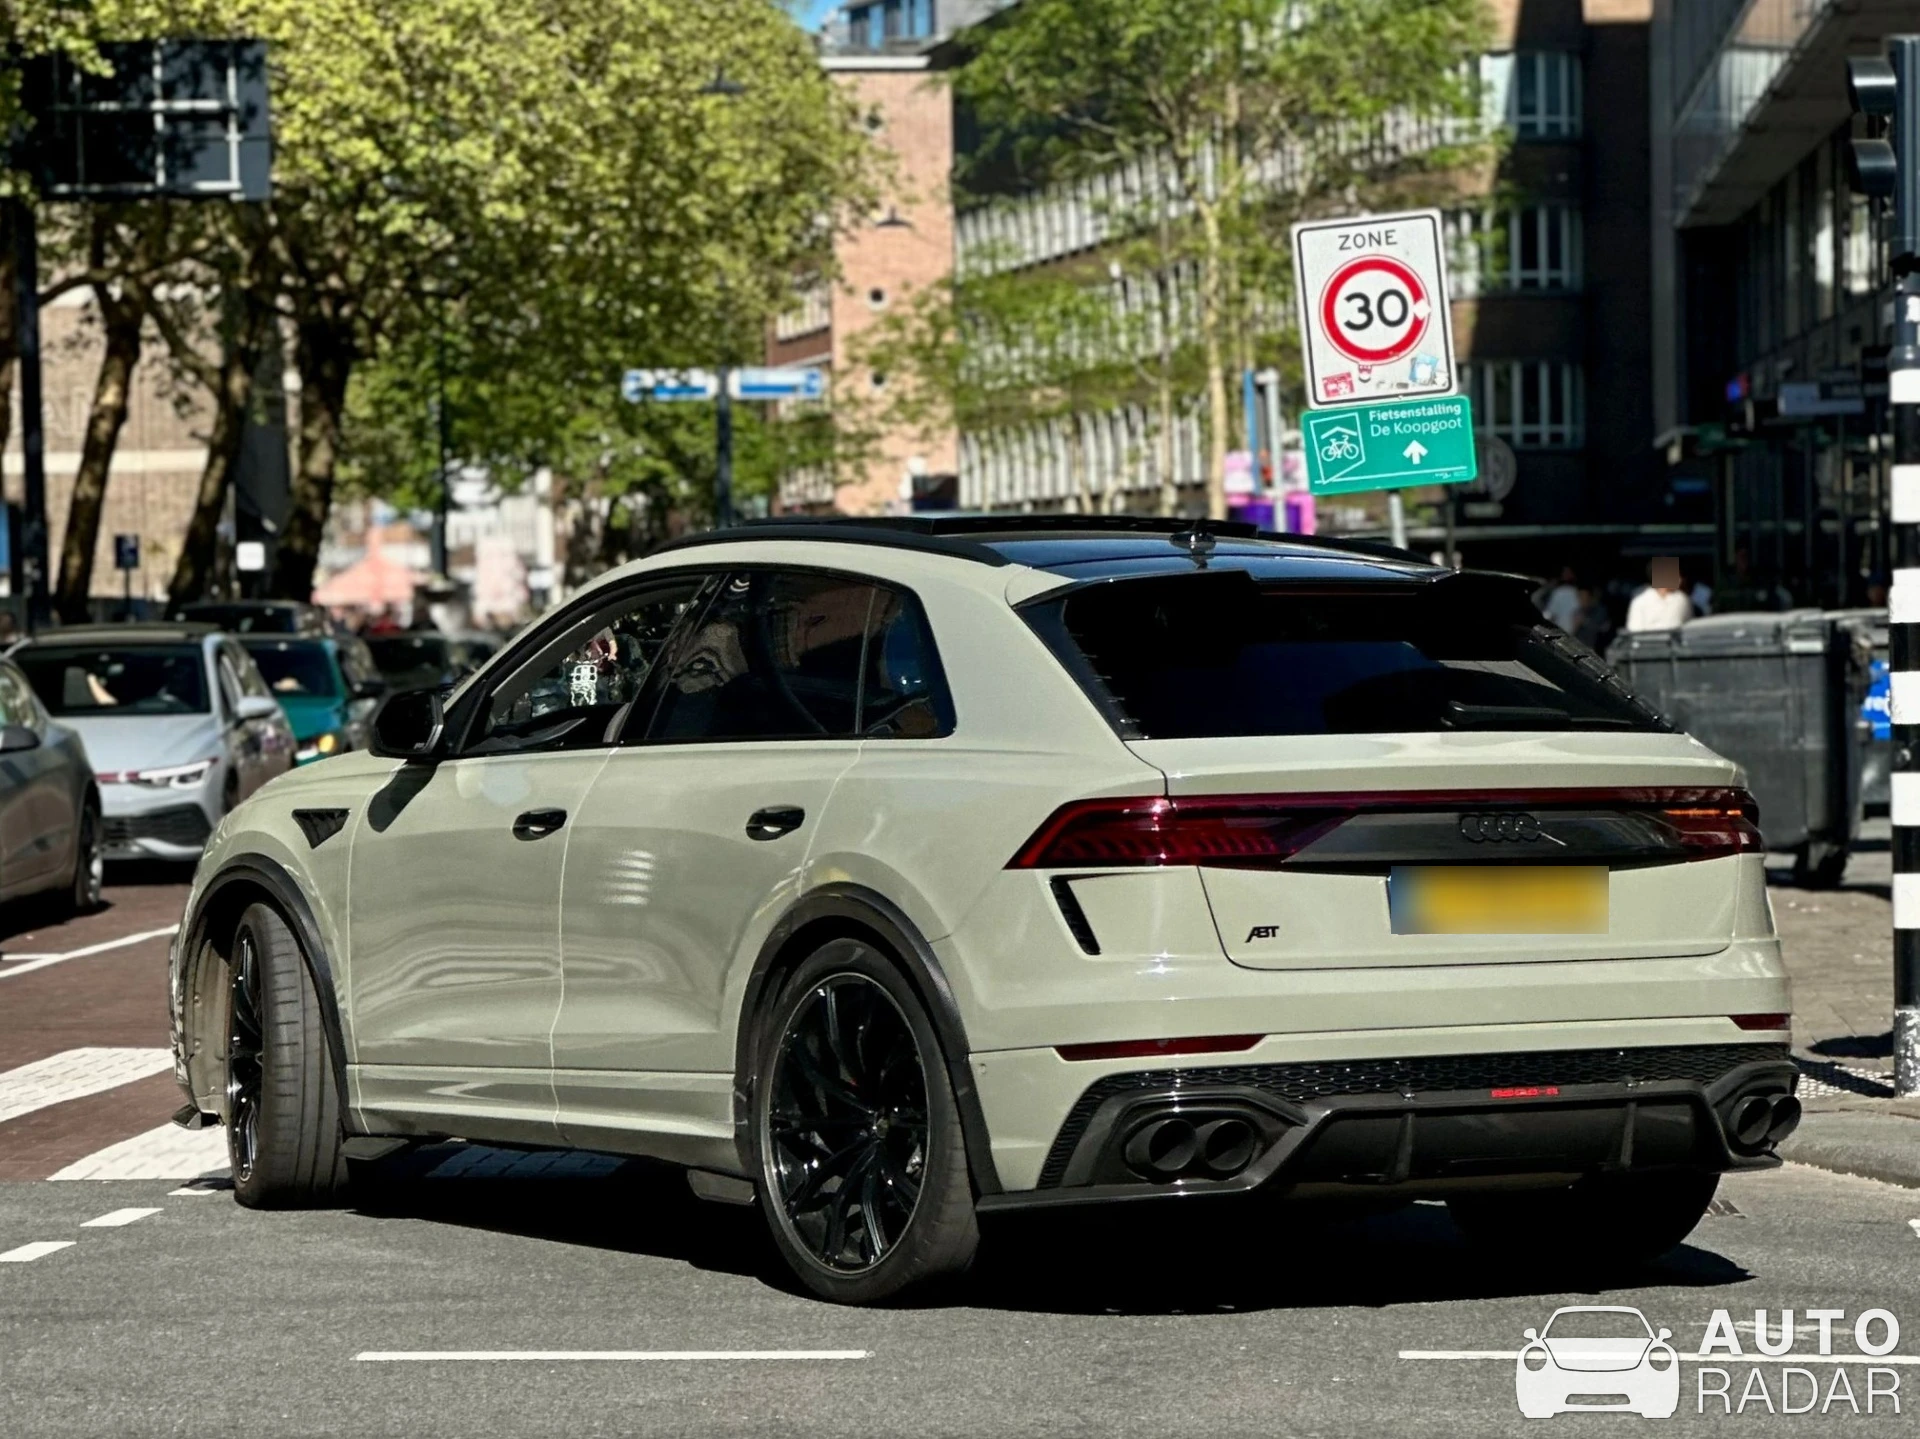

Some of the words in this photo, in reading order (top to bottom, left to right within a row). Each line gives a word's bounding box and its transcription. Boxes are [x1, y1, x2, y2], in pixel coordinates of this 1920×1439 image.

[1338, 229, 1398, 250] ZONE
[1344, 289, 1409, 331] 30
[1369, 404, 1462, 421] Fietsenstalling
[1370, 424, 1391, 437] De
[1394, 417, 1463, 434] Koopgoot
[1244, 925, 1280, 943] ABT
